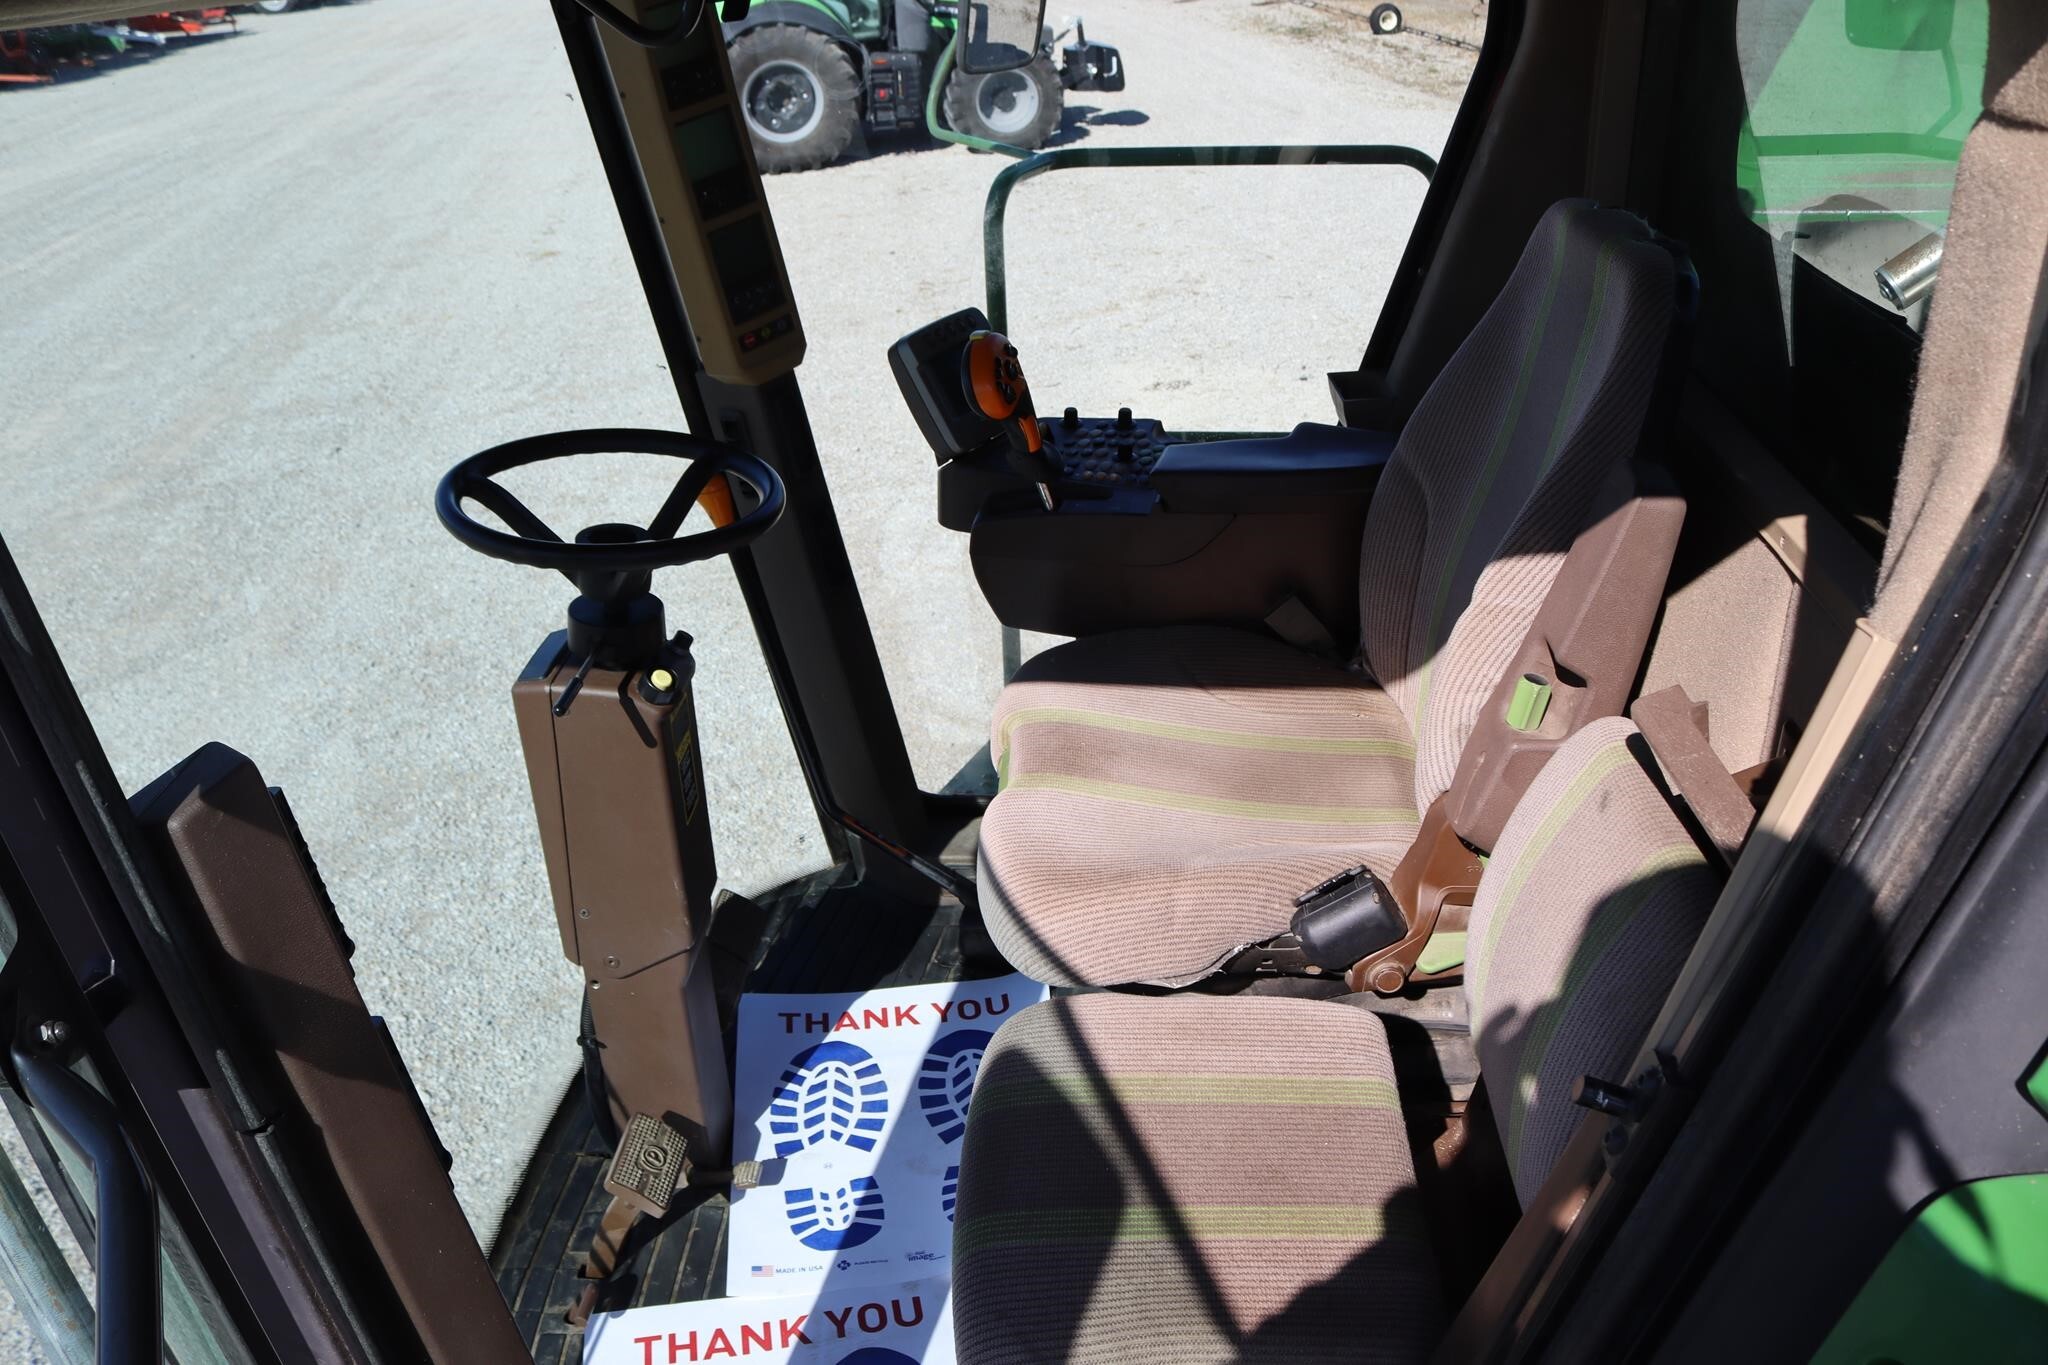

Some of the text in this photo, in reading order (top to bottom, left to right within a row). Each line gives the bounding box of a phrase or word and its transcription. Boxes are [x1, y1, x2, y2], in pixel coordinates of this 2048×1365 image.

[778, 993, 1010, 1034] THANK YOU
[808, 1264, 824, 1272] USA
[634, 1296, 924, 1365] THANK YOU
